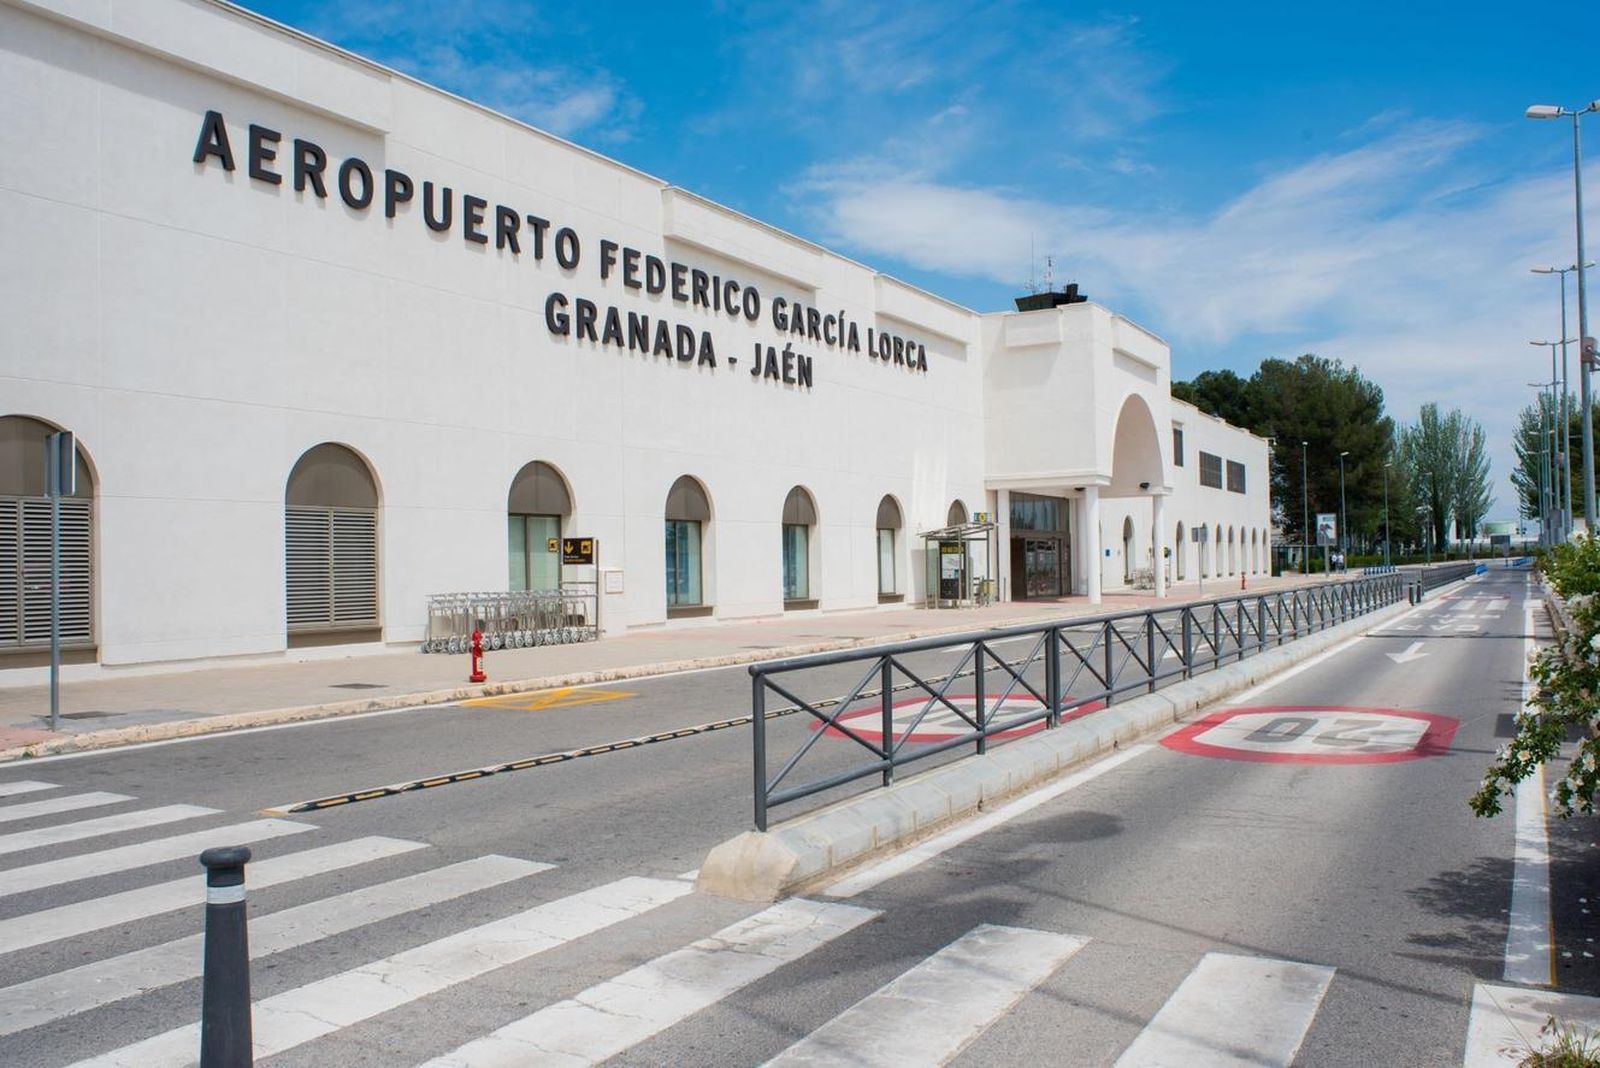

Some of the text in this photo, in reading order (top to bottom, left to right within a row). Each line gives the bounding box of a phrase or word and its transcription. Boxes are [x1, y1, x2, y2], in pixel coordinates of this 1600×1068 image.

[193, 110, 928, 372] AEROPUERTO FEDERICO GARCÍA LORCA
[545, 292, 717, 368] GRANADA
[750, 343, 813, 388] JAÉN
[1243, 717, 1384, 746] 20
